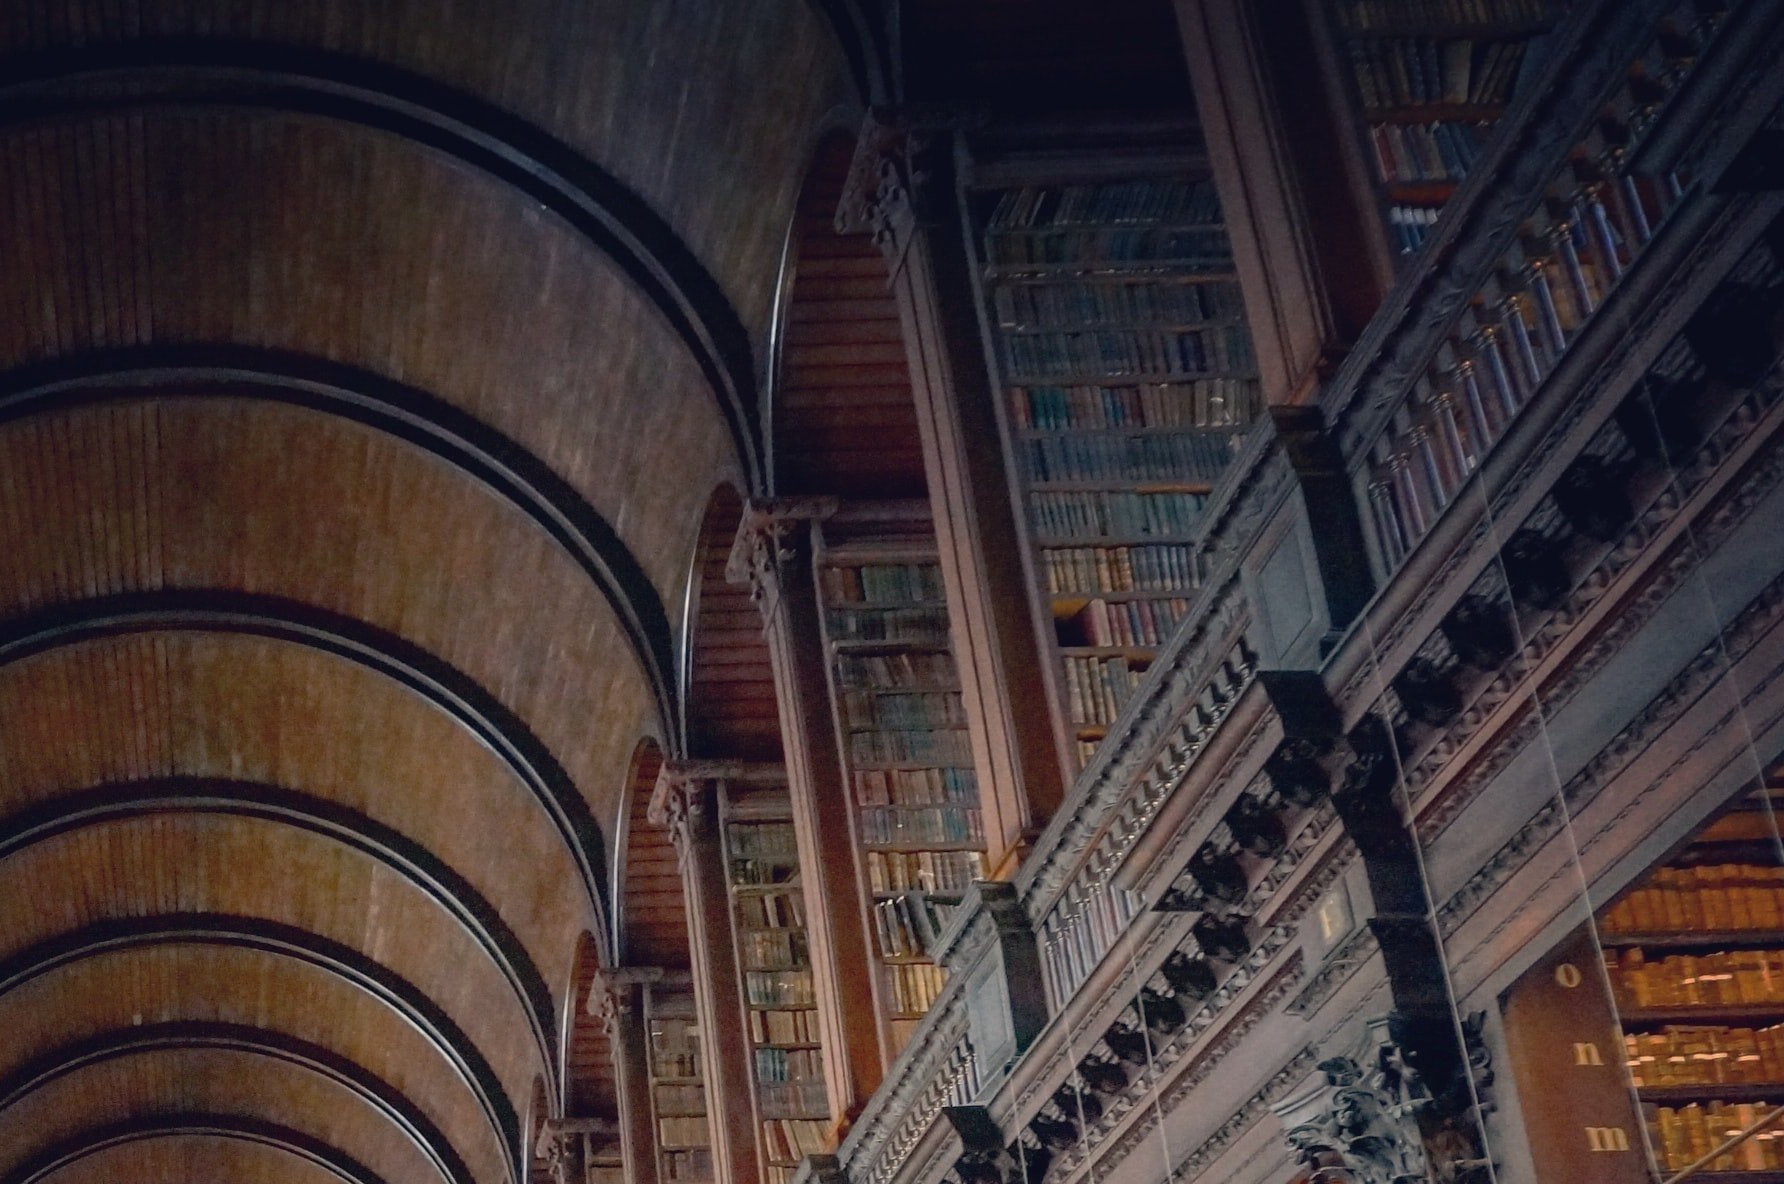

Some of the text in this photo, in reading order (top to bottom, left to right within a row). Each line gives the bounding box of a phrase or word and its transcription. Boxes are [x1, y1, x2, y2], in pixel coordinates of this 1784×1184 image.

[1556, 964, 1581, 988] o
[1574, 1043, 1603, 1065] n
[1585, 1127, 1629, 1151] m
